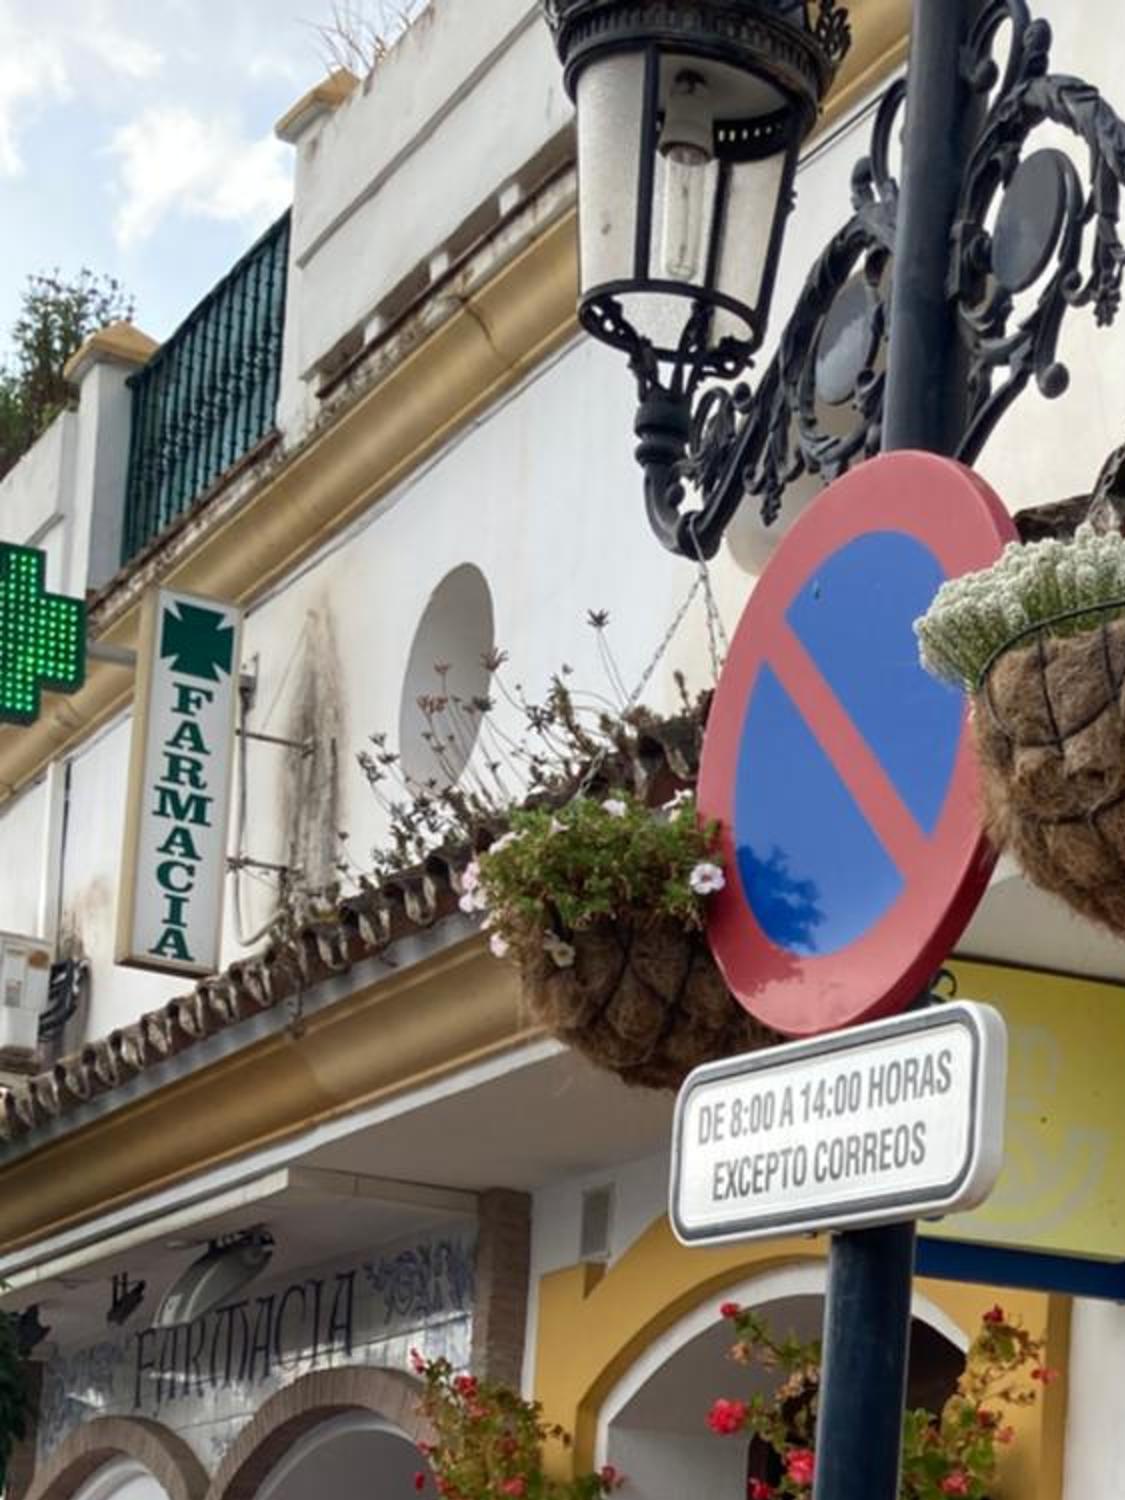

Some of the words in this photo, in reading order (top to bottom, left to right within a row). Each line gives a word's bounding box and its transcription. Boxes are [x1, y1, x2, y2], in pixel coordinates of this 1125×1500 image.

[148, 681, 214, 962] FARMACIA
[698, 1102, 725, 1146] DE
[729, 1090, 775, 1138] 8:00
[778, 1086, 794, 1128] A
[799, 1070, 862, 1123] 14:00
[867, 1049, 952, 1109] HORAS
[712, 1145, 807, 1202] EXCEPTO
[813, 1121, 927, 1183] CORREOS
[134, 1270, 356, 1410] FARMACIA
